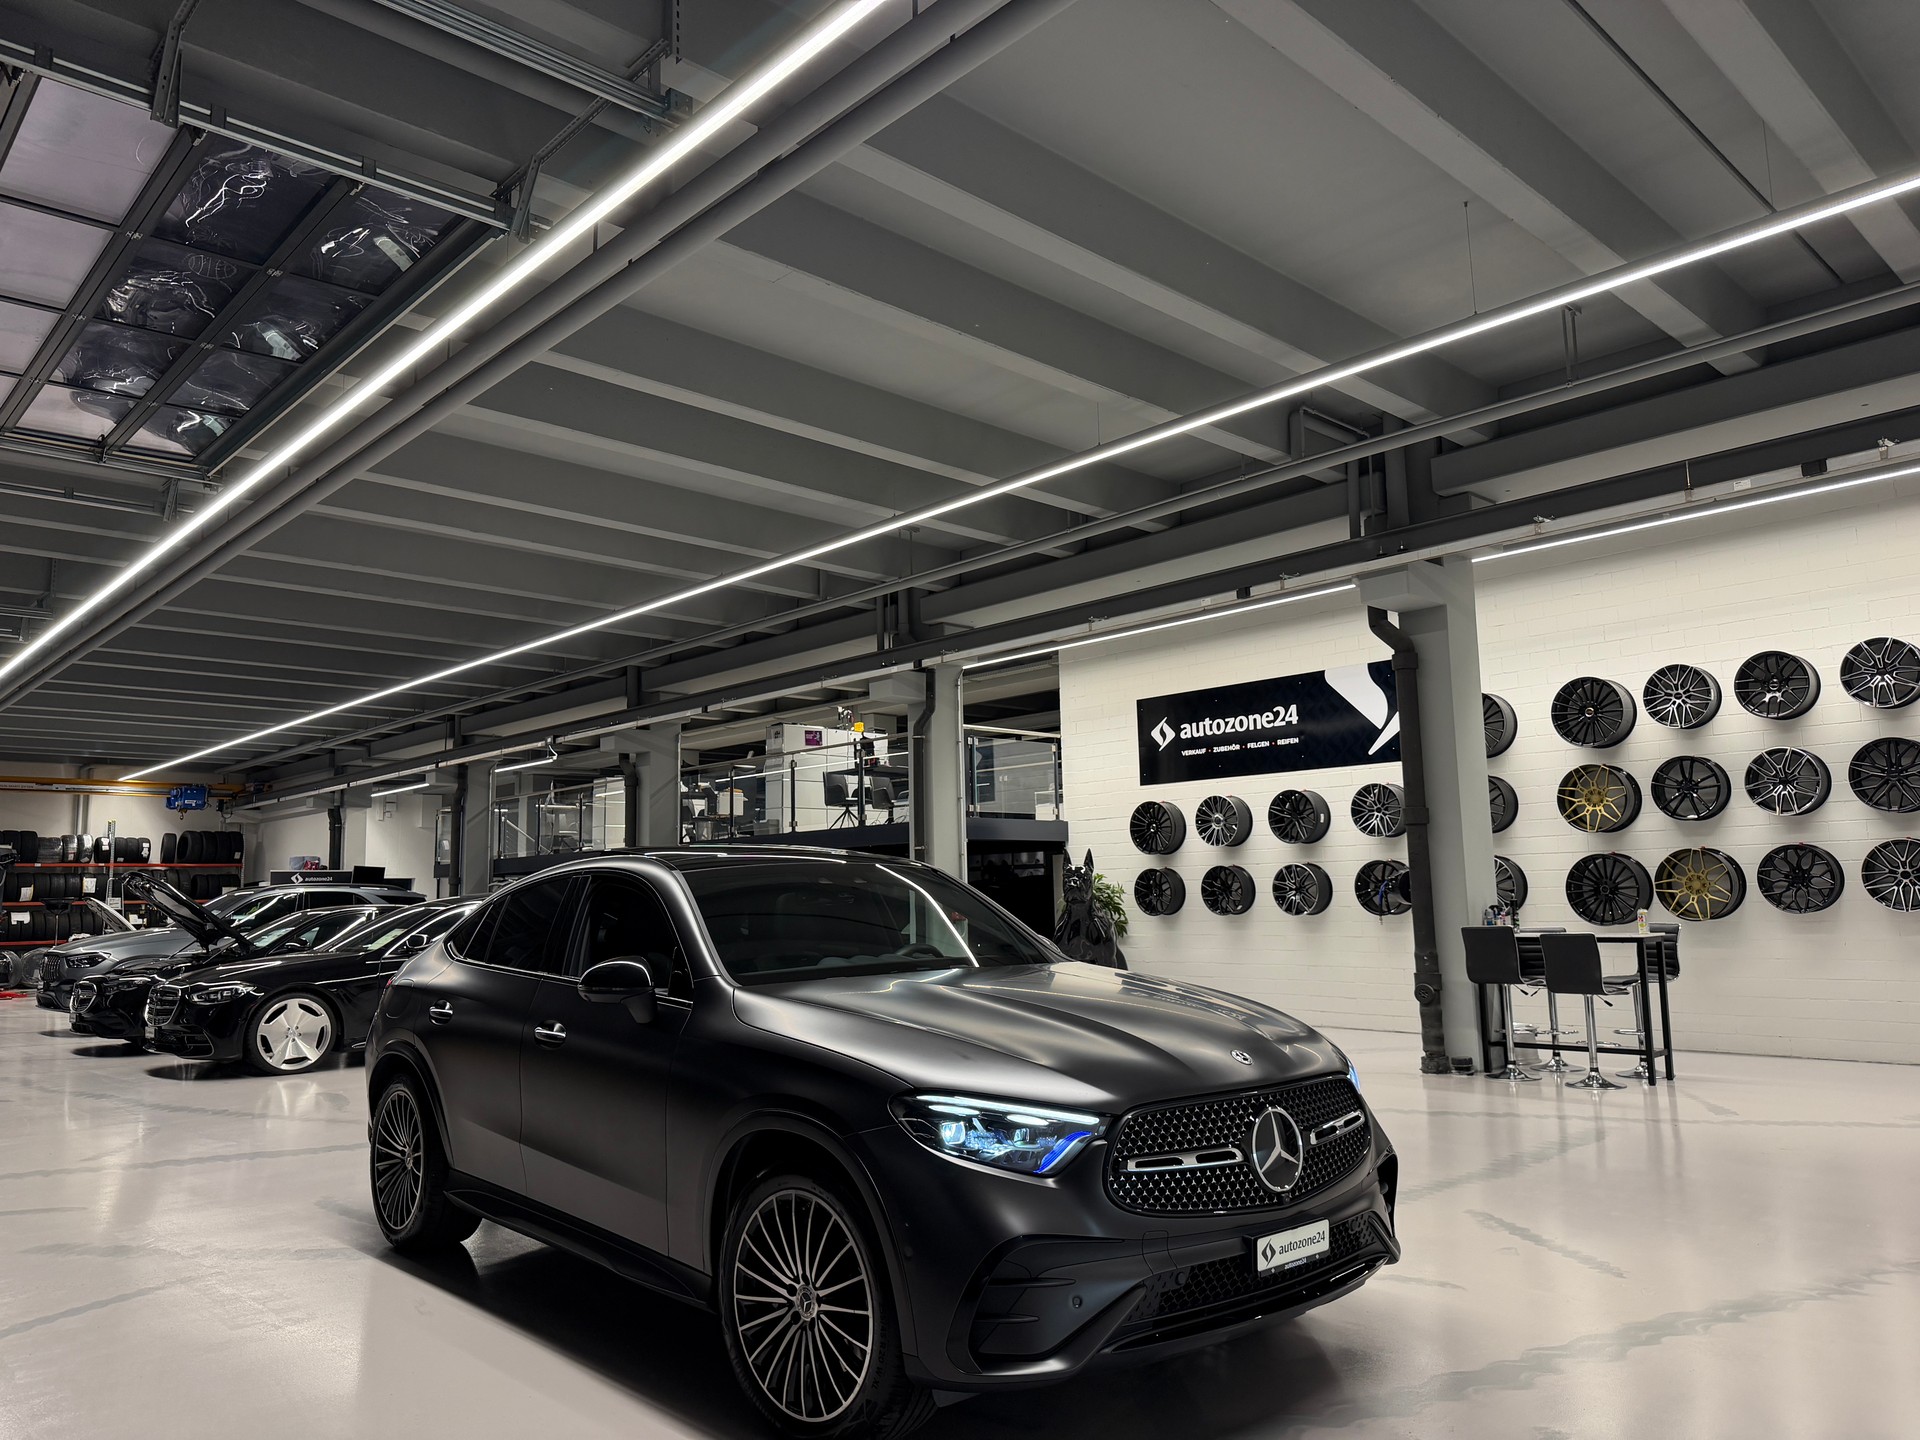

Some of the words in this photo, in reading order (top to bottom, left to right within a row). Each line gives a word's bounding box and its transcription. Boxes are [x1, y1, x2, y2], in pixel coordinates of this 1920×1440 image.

[1180, 704, 1299, 739] autozone24
[1181, 748, 1207, 757] VERKAUF
[1213, 744, 1241, 753] ZUBEHÖR
[1247, 741, 1270, 749] FELGEN
[1277, 737, 1299, 745] REIFEN
[1279, 1230, 1326, 1255] autozone24
